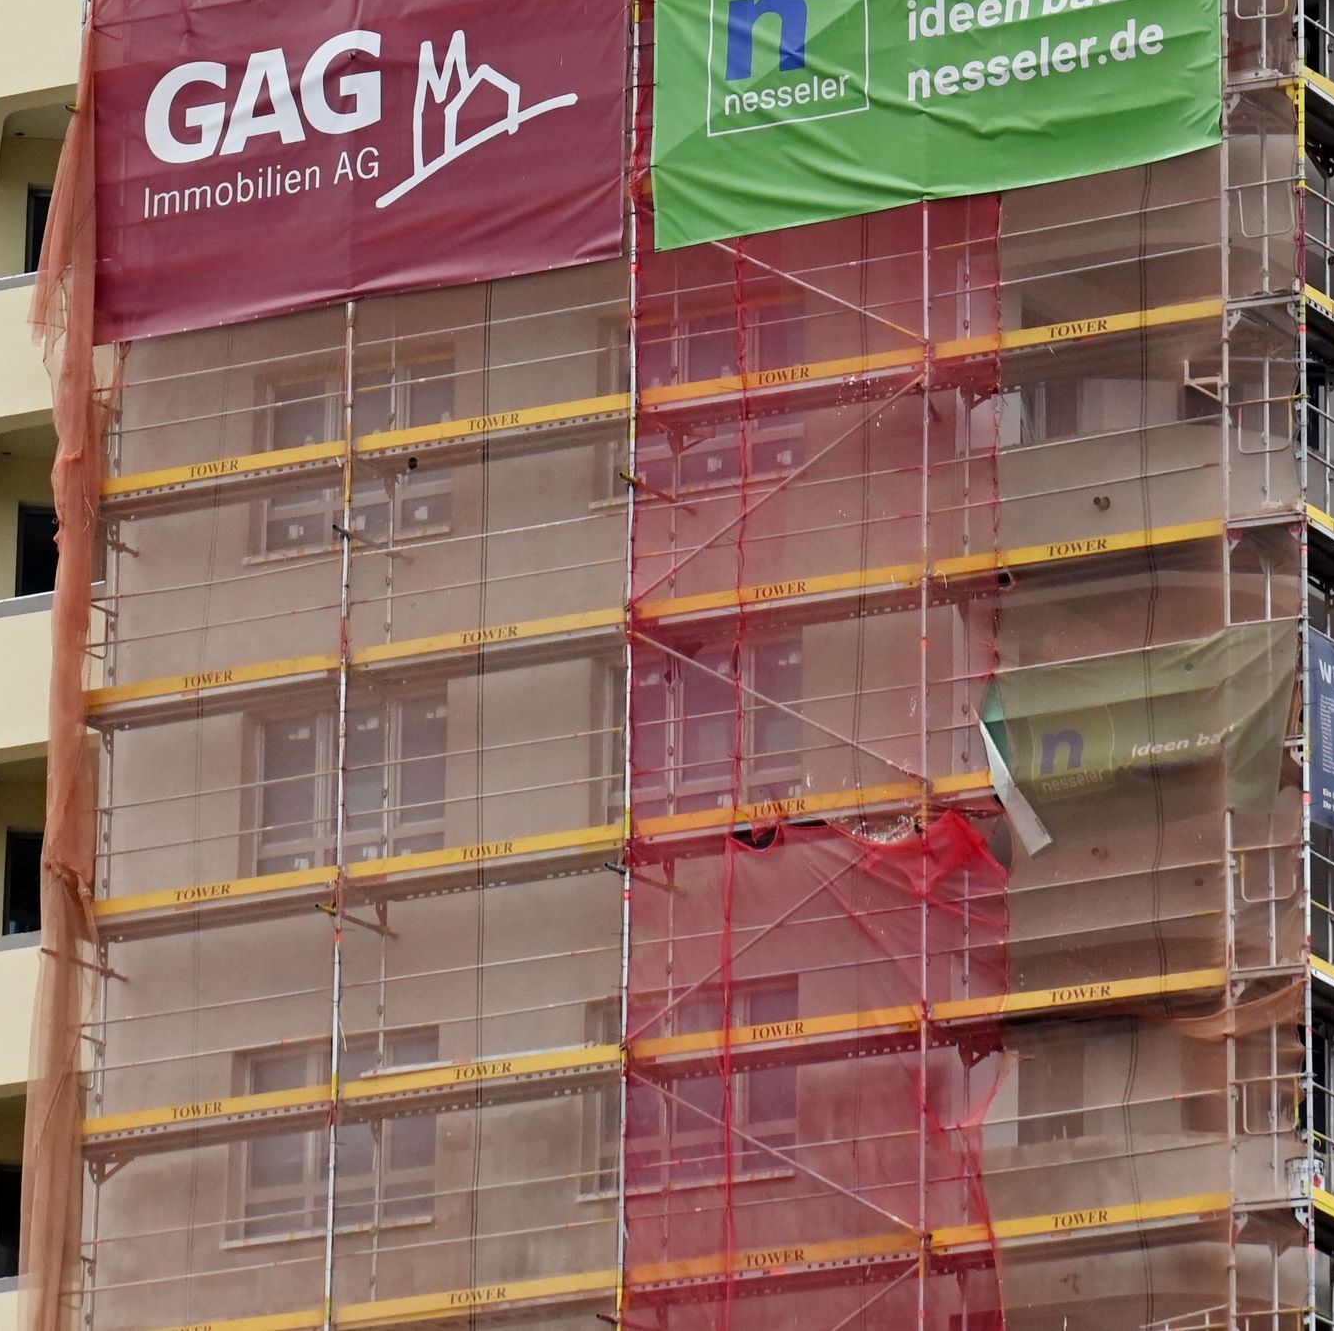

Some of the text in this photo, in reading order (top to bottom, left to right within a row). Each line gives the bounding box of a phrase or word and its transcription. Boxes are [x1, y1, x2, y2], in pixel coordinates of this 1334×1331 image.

[907, 20, 1164, 102] nesseler.de
[144, 30, 381, 163] GAG
[724, 73, 849, 116] nesseler
[144, 147, 380, 219] Immobilien AG
[1050, 319, 1107, 338] TOWER
[757, 366, 810, 384] TOWER
[468, 411, 520, 430] TOWER
[189, 458, 239, 476] TOWER
[1049, 537, 1108, 555] TOWER
[753, 581, 807, 598] TOWER
[461, 624, 519, 642] TOWER
[183, 670, 234, 689] TOWER
[1131, 739, 1189, 758] ideen
[1042, 769, 1104, 793] nesseler
[753, 798, 806, 817] TOWER
[461, 840, 513, 860] TOWER
[175, 882, 231, 901] TOWER
[1050, 983, 1112, 1004] TOWER
[751, 1020, 805, 1039] TOWER
[454, 1059, 512, 1079] TOWER
[172, 1100, 223, 1119] TOWER
[1053, 1209, 1109, 1229] TOWER
[745, 1248, 805, 1267] TOWER
[448, 1286, 507, 1304] TOWER
